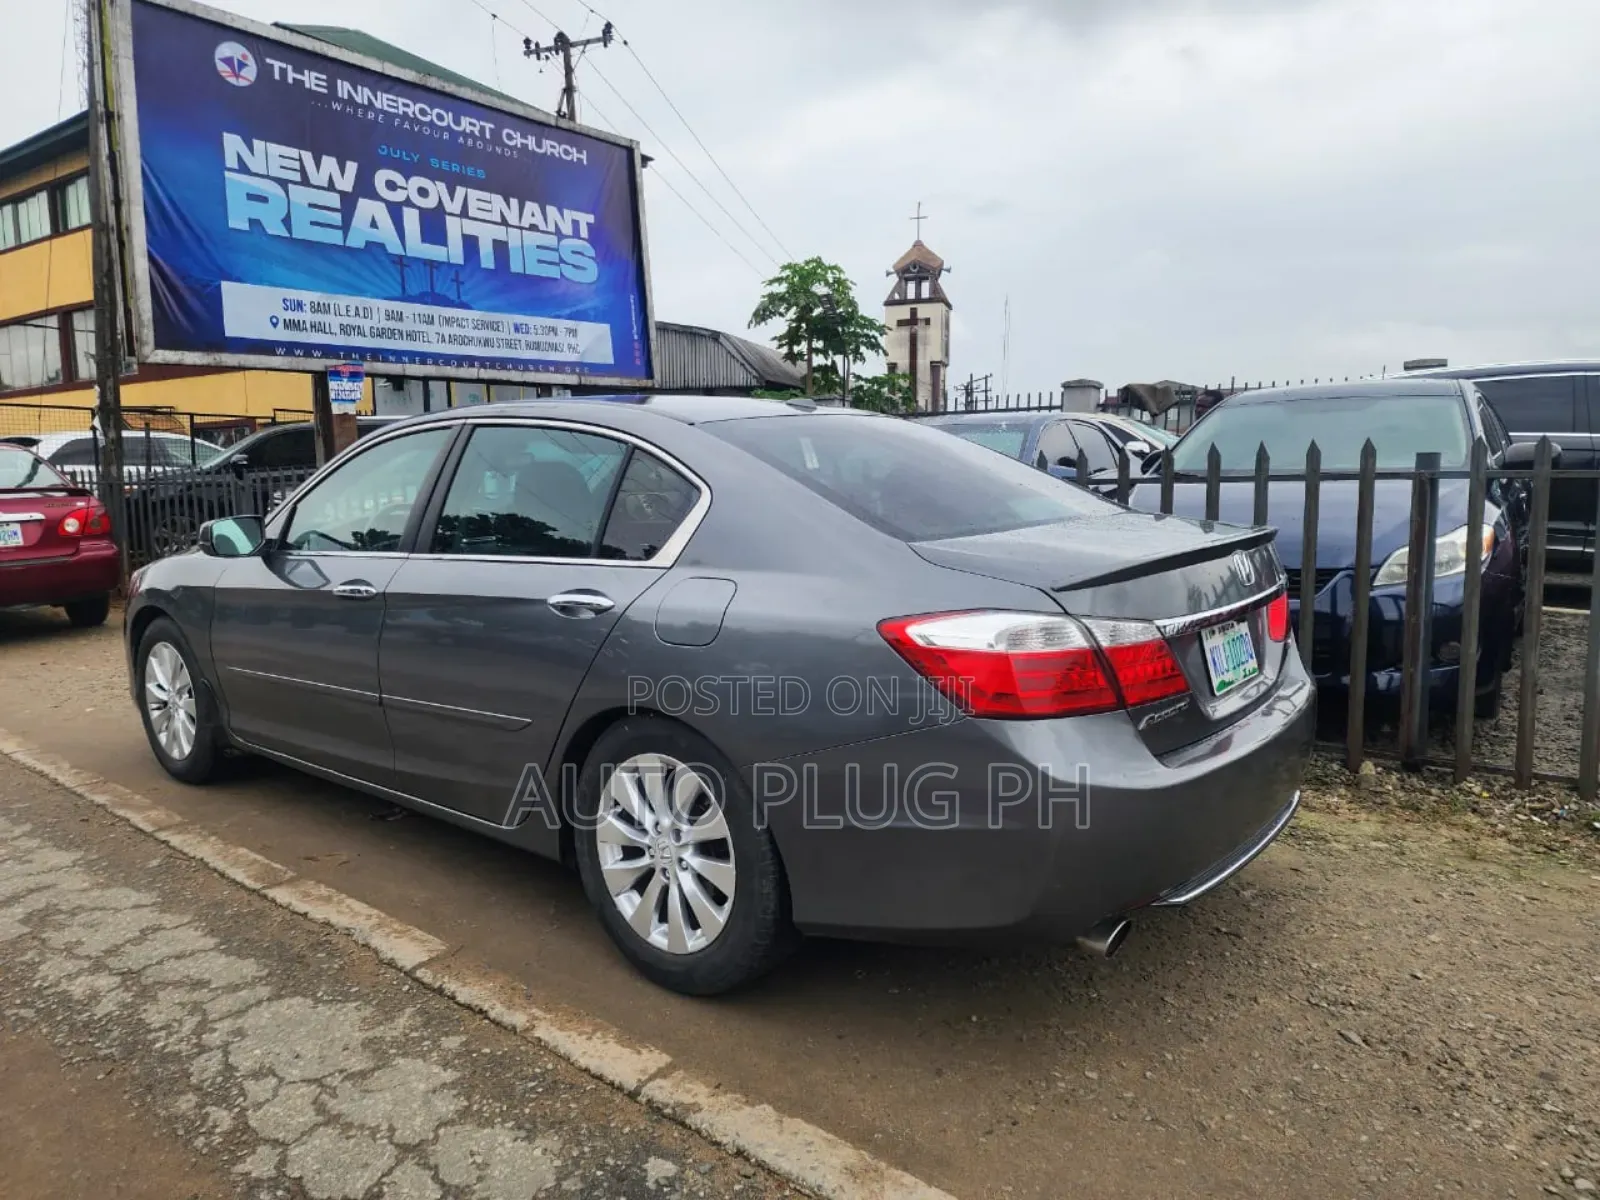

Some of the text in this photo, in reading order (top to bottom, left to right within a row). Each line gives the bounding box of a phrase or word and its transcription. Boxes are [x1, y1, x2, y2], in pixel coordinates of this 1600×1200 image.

[265, 57, 588, 165] THE INNERCOURT CHURCH
[394, 118, 450, 141] FAVOUR
[377, 144, 486, 180] JULY SERIES
[222, 131, 595, 240] NEW COVENANT
[223, 170, 599, 285] REALITIES
[282, 297, 307, 313] SUN:
[309, 300, 331, 315] 8AM
[384, 307, 403, 322] 9AM
[412, 311, 435, 326] 11AM
[438, 314, 470, 330] (IMPACT
[471, 318, 505, 333] SERVICE)
[513, 322, 532, 335] WED:
[283, 318, 308, 332] MMA
[310, 320, 337, 337] HALL,
[339, 323, 366, 338] ROYAL
[369, 325, 404, 341] GARDEN
[434, 332, 446, 344] 7A
[448, 334, 495, 349] AROCHUKWU
